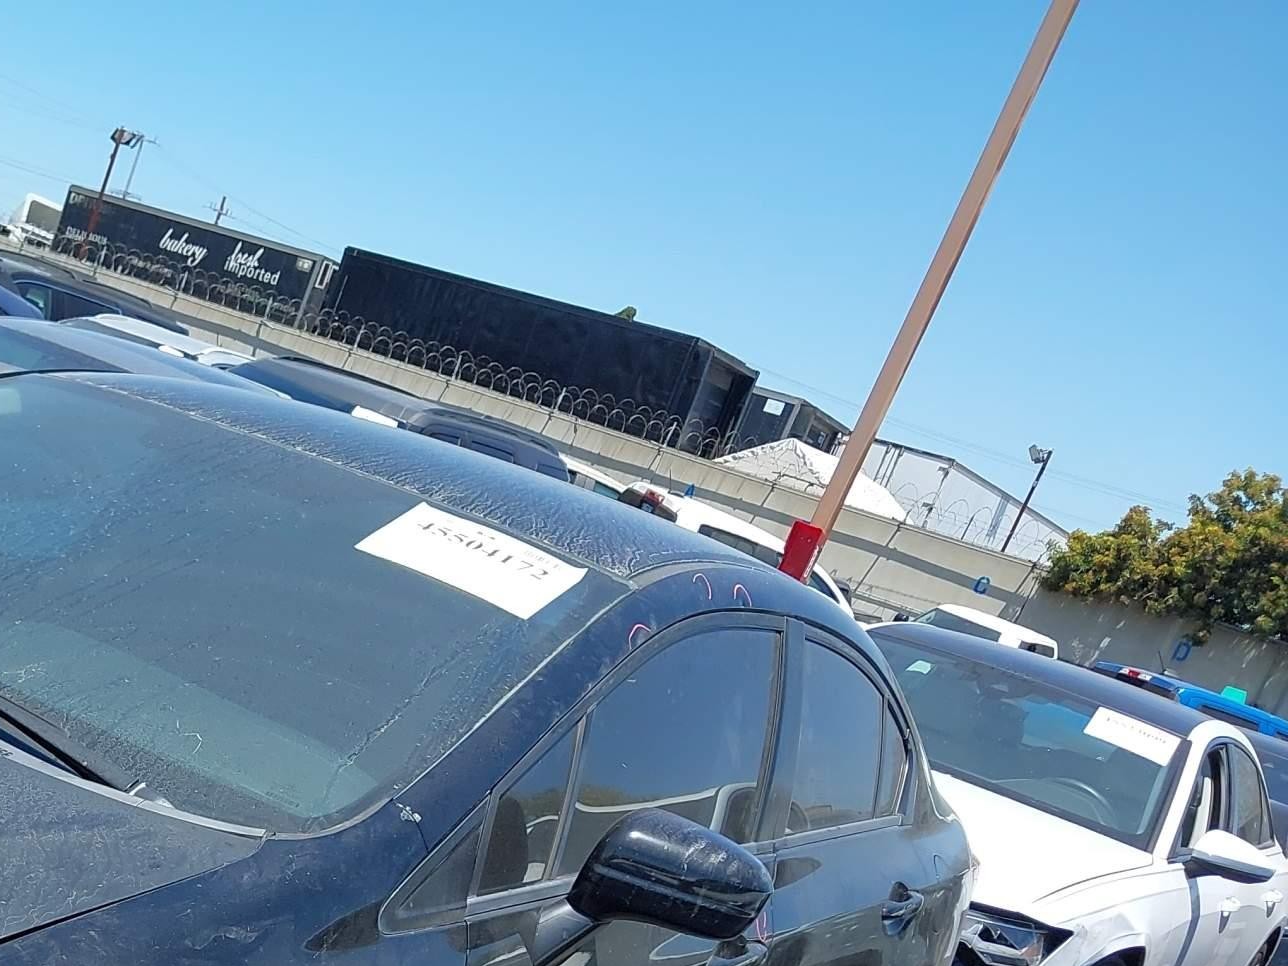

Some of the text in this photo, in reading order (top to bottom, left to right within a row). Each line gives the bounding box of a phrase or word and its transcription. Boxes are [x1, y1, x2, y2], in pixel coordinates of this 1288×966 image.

[158, 227, 208, 267] bakery
[231, 240, 265, 267] fresh
[223, 256, 281, 285] imported
[416, 521, 550, 581] 45504172
[972, 576, 991, 594] C
